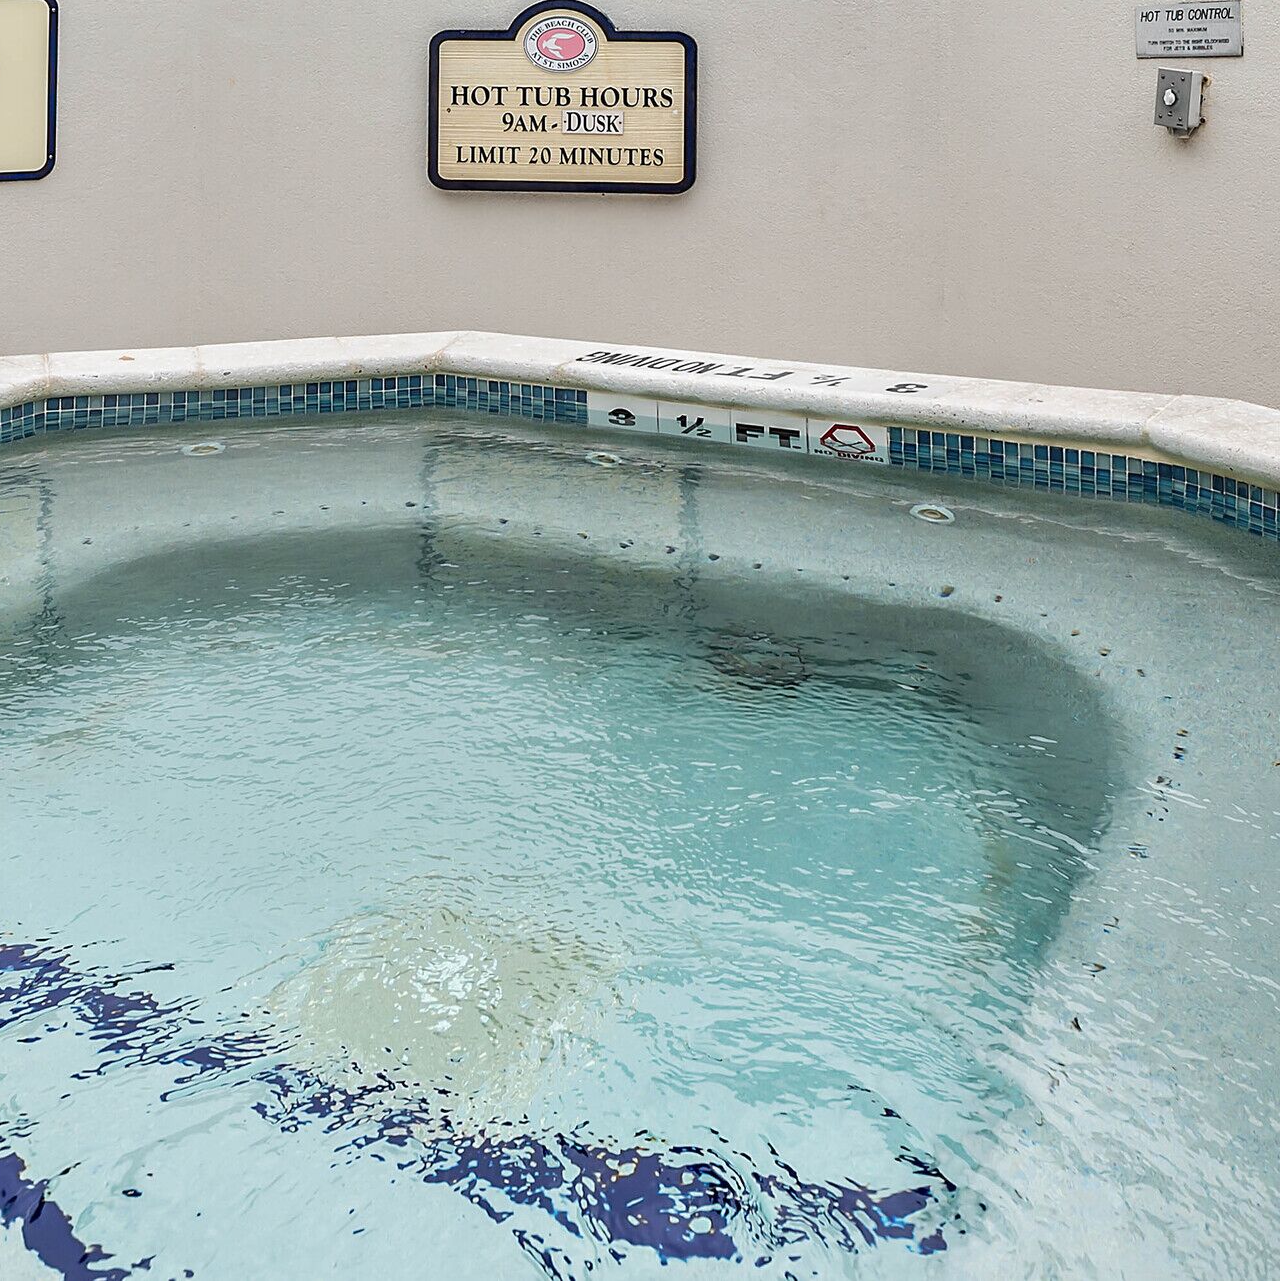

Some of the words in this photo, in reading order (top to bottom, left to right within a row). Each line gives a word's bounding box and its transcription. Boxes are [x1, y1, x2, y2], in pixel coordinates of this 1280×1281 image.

[1140, 10, 1160, 22] HOT
[1165, 9, 1184, 21] TUB
[1188, 7, 1234, 21] CONTROL
[529, 26, 545, 42] THE
[544, 20, 575, 29] BEACH
[575, 25, 594, 44] CLUB
[531, 52, 542, 61] AT
[557, 52, 590, 69] SIMONS
[450, 85, 509, 106] HOT
[516, 87, 571, 107] TUB
[580, 87, 674, 108] HOURS
[566, 112, 620, 133] DUSK
[456, 146, 521, 165] LIMIT
[529, 147, 551, 165] 20
[559, 148, 664, 167] MINUTES
[576, 351, 684, 369] DIVING
[672, 361, 724, 374] NO
[885, 383, 928, 393] 3
[608, 408, 636, 426] 3
[735, 422, 802, 449] FT.
[814, 448, 832, 456] NO
[837, 451, 884, 463] DIVING
